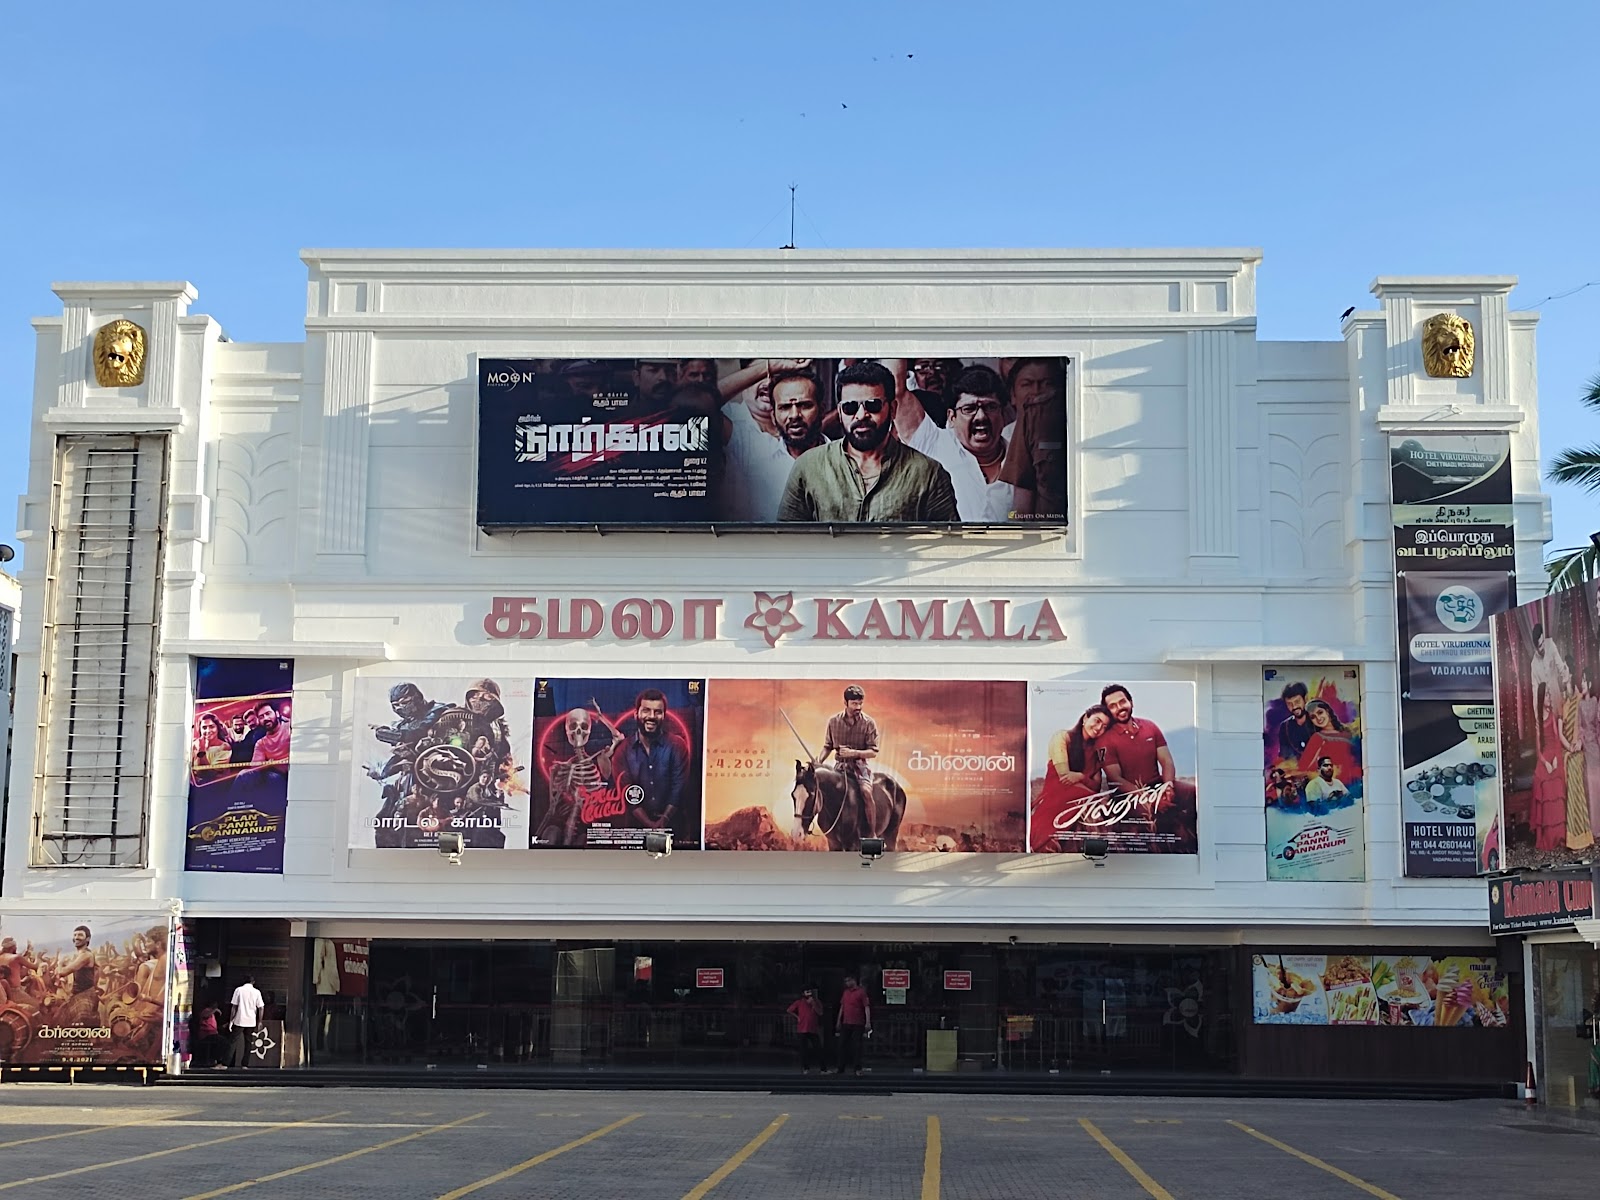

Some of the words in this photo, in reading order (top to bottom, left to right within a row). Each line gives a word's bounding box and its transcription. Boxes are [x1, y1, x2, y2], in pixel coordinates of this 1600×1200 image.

[515, 417, 709, 462] நாற்காலி
[1410, 451, 1439, 460] HOTEL
[1440, 453, 1495, 462] VIRUDHUNAGAR
[1415, 529, 1495, 545] இப்பொழுது
[1397, 544, 1514, 559] வடபழனியிலும்
[483, 597, 724, 640] கமலா
[812, 598, 1068, 641] KAMALA
[1414, 640, 1440, 648] HOTEL
[1430, 666, 1490, 675] VADAPALANI
[907, 750, 1016, 773] கர்ணன்
[1053, 780, 1175, 829] சுல்தான்
[225, 814, 260, 823] PLAN
[364, 815, 440, 831] மார்டல்
[450, 815, 523, 829] காம்பட்
[1300, 829, 1329, 841] PLAN
[1413, 825, 1444, 837] HOTEL
[1446, 826, 1475, 837] VIRUD
[1410, 841, 1422, 849] PH:
[1423, 841, 1437, 849] 044
[1438, 841, 1471, 849] 42601444
[1503, 880, 1560, 918] Kamala
[38, 1025, 112, 1039] கர்ணன்
